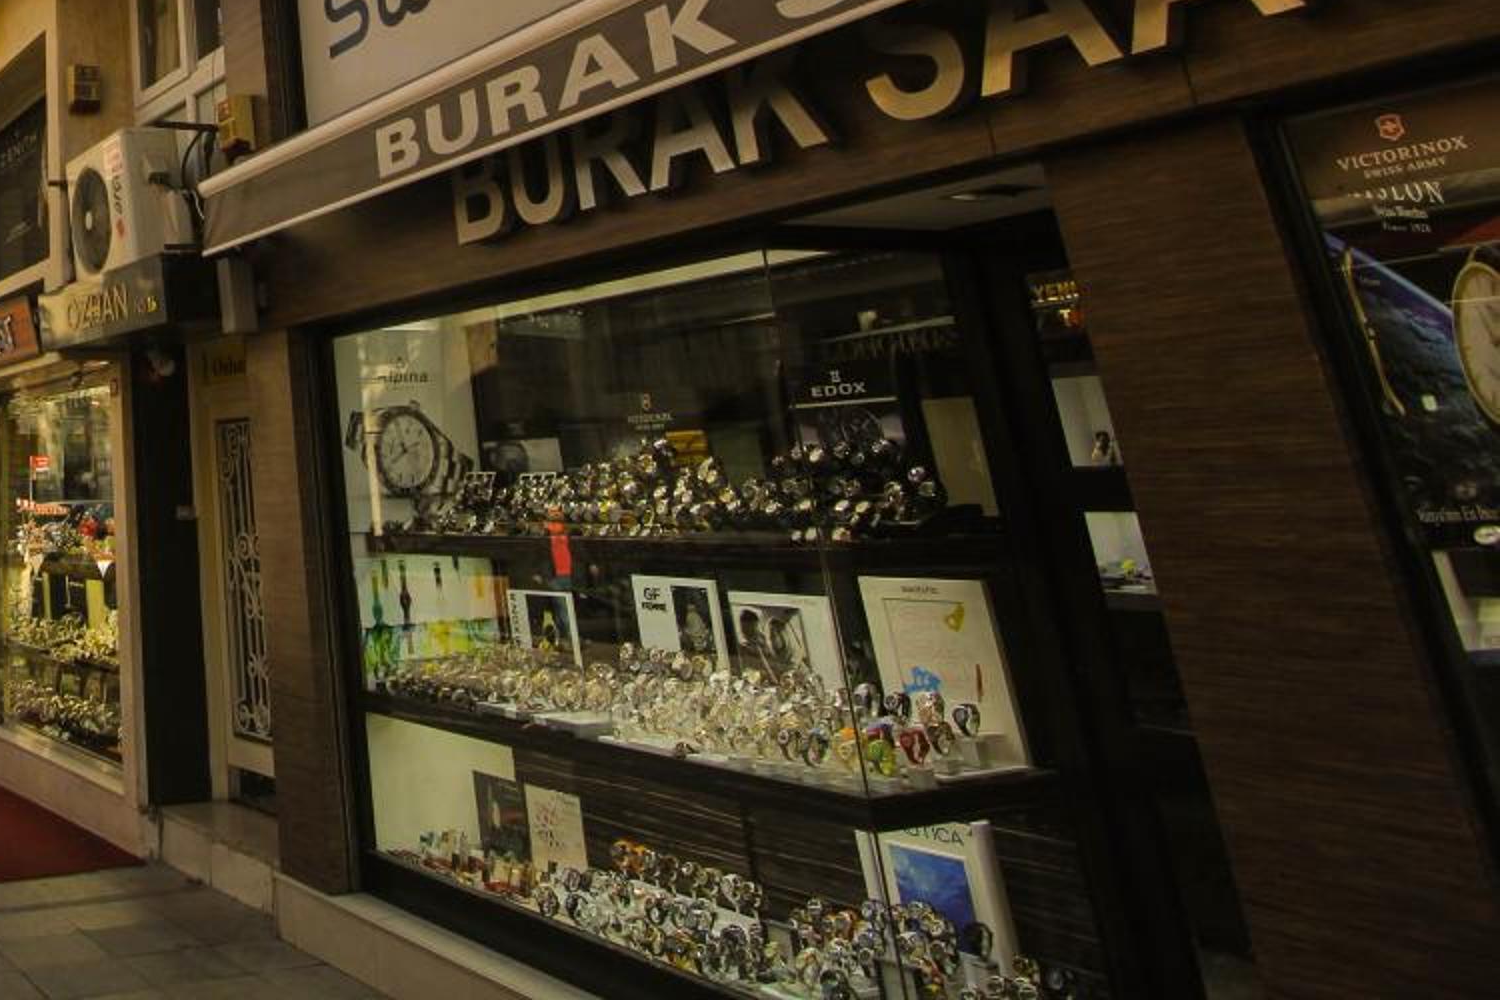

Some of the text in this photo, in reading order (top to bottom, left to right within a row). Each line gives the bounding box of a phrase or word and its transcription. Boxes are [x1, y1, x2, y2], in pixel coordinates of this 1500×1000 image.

[455, 64, 830, 246] BURAK
[1335, 135, 1469, 172] VICTORINOX
[810, 381, 867, 398] EDOX
[643, 587, 662, 601] GF
